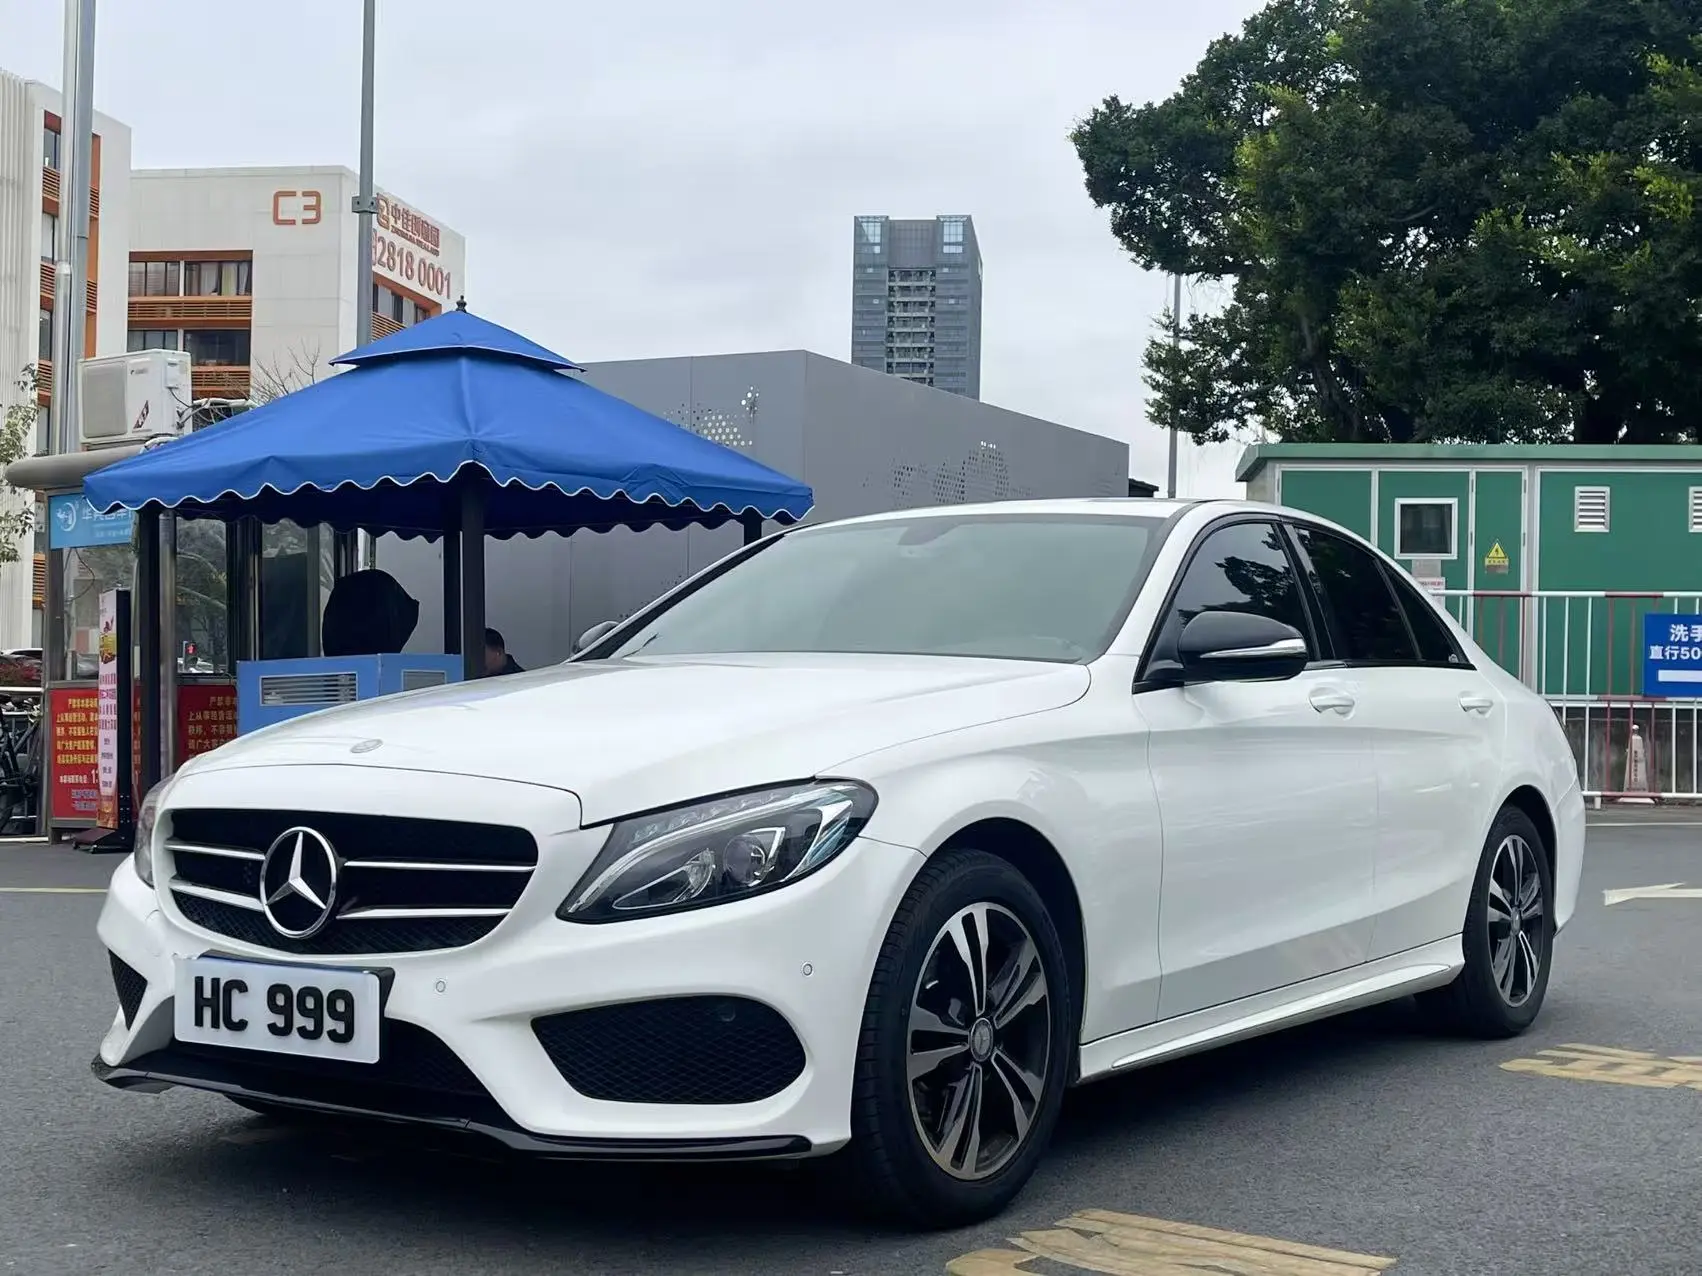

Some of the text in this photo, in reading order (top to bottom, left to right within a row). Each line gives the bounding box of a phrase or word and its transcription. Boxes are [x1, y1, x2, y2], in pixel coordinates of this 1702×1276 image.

[273, 191, 321, 225] C3
[418, 257, 451, 300] 0001
[194, 976, 355, 1043] HC 999
